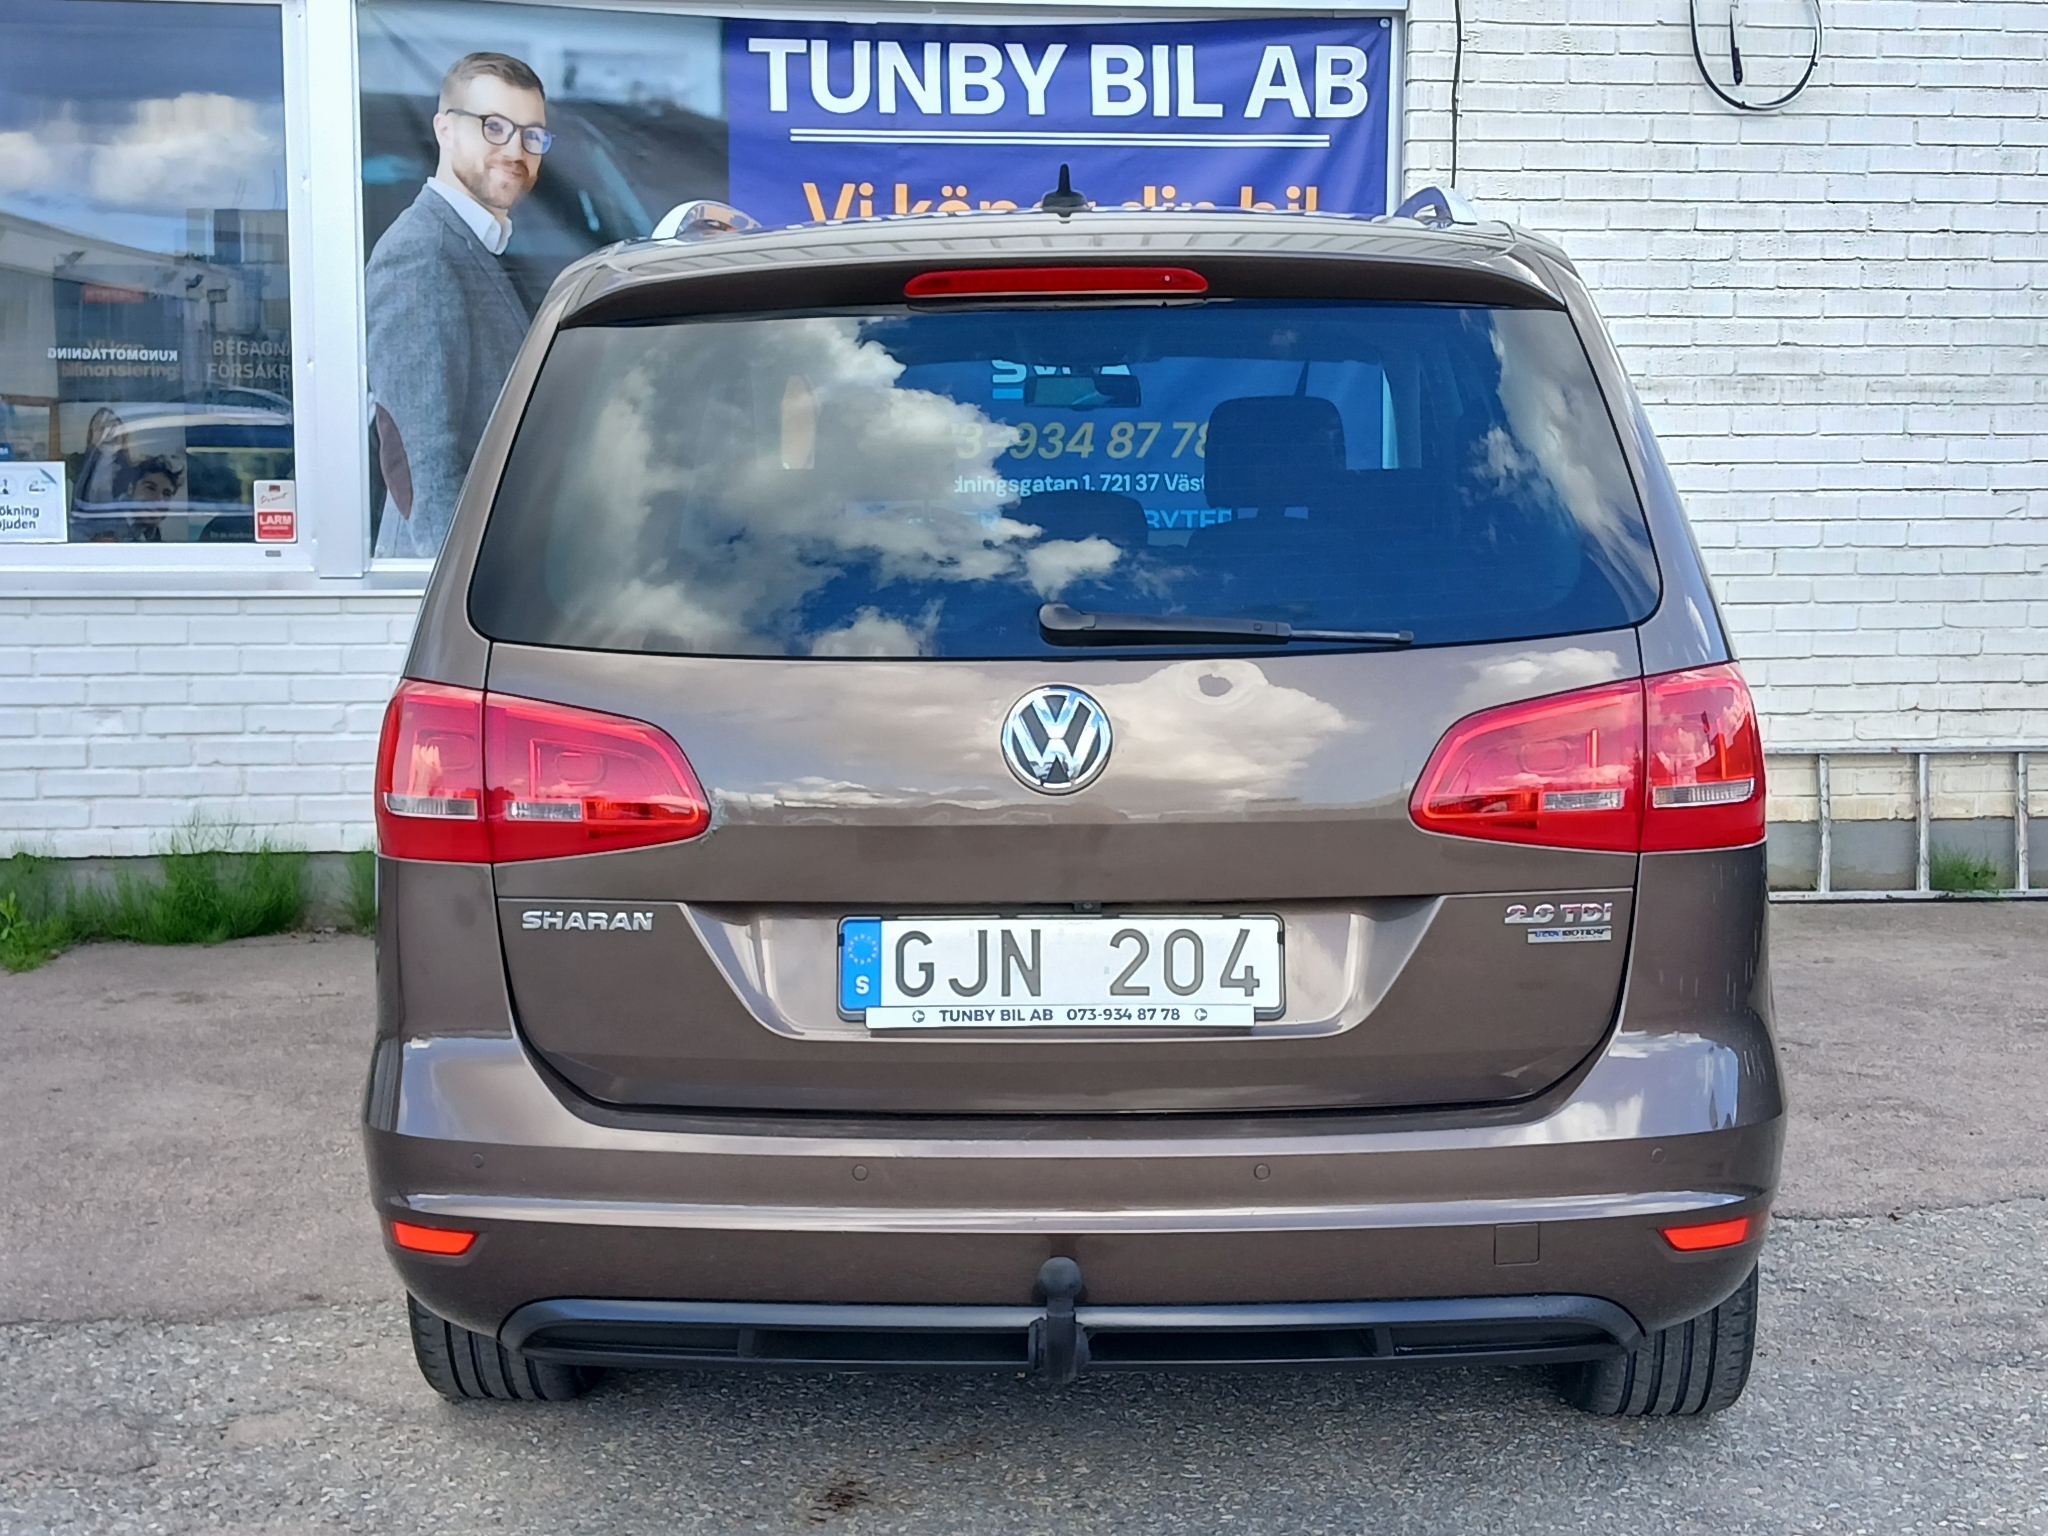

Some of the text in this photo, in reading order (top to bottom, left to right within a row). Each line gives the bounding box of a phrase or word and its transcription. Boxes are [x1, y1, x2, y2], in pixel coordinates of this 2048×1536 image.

[749, 38, 1369, 118] TUNBY BIL AB
[1106, 421, 1161, 459] 87
[1100, 474, 1130, 491] 721
[1136, 474, 1159, 491] 37
[522, 911, 654, 931] SHARAN
[1560, 902, 1613, 923] TDI
[895, 928, 1260, 998] GJN 204
[855, 975, 870, 995] S
[938, 1008, 1181, 1022] TUNBY BIL AB 073-934 87 78
